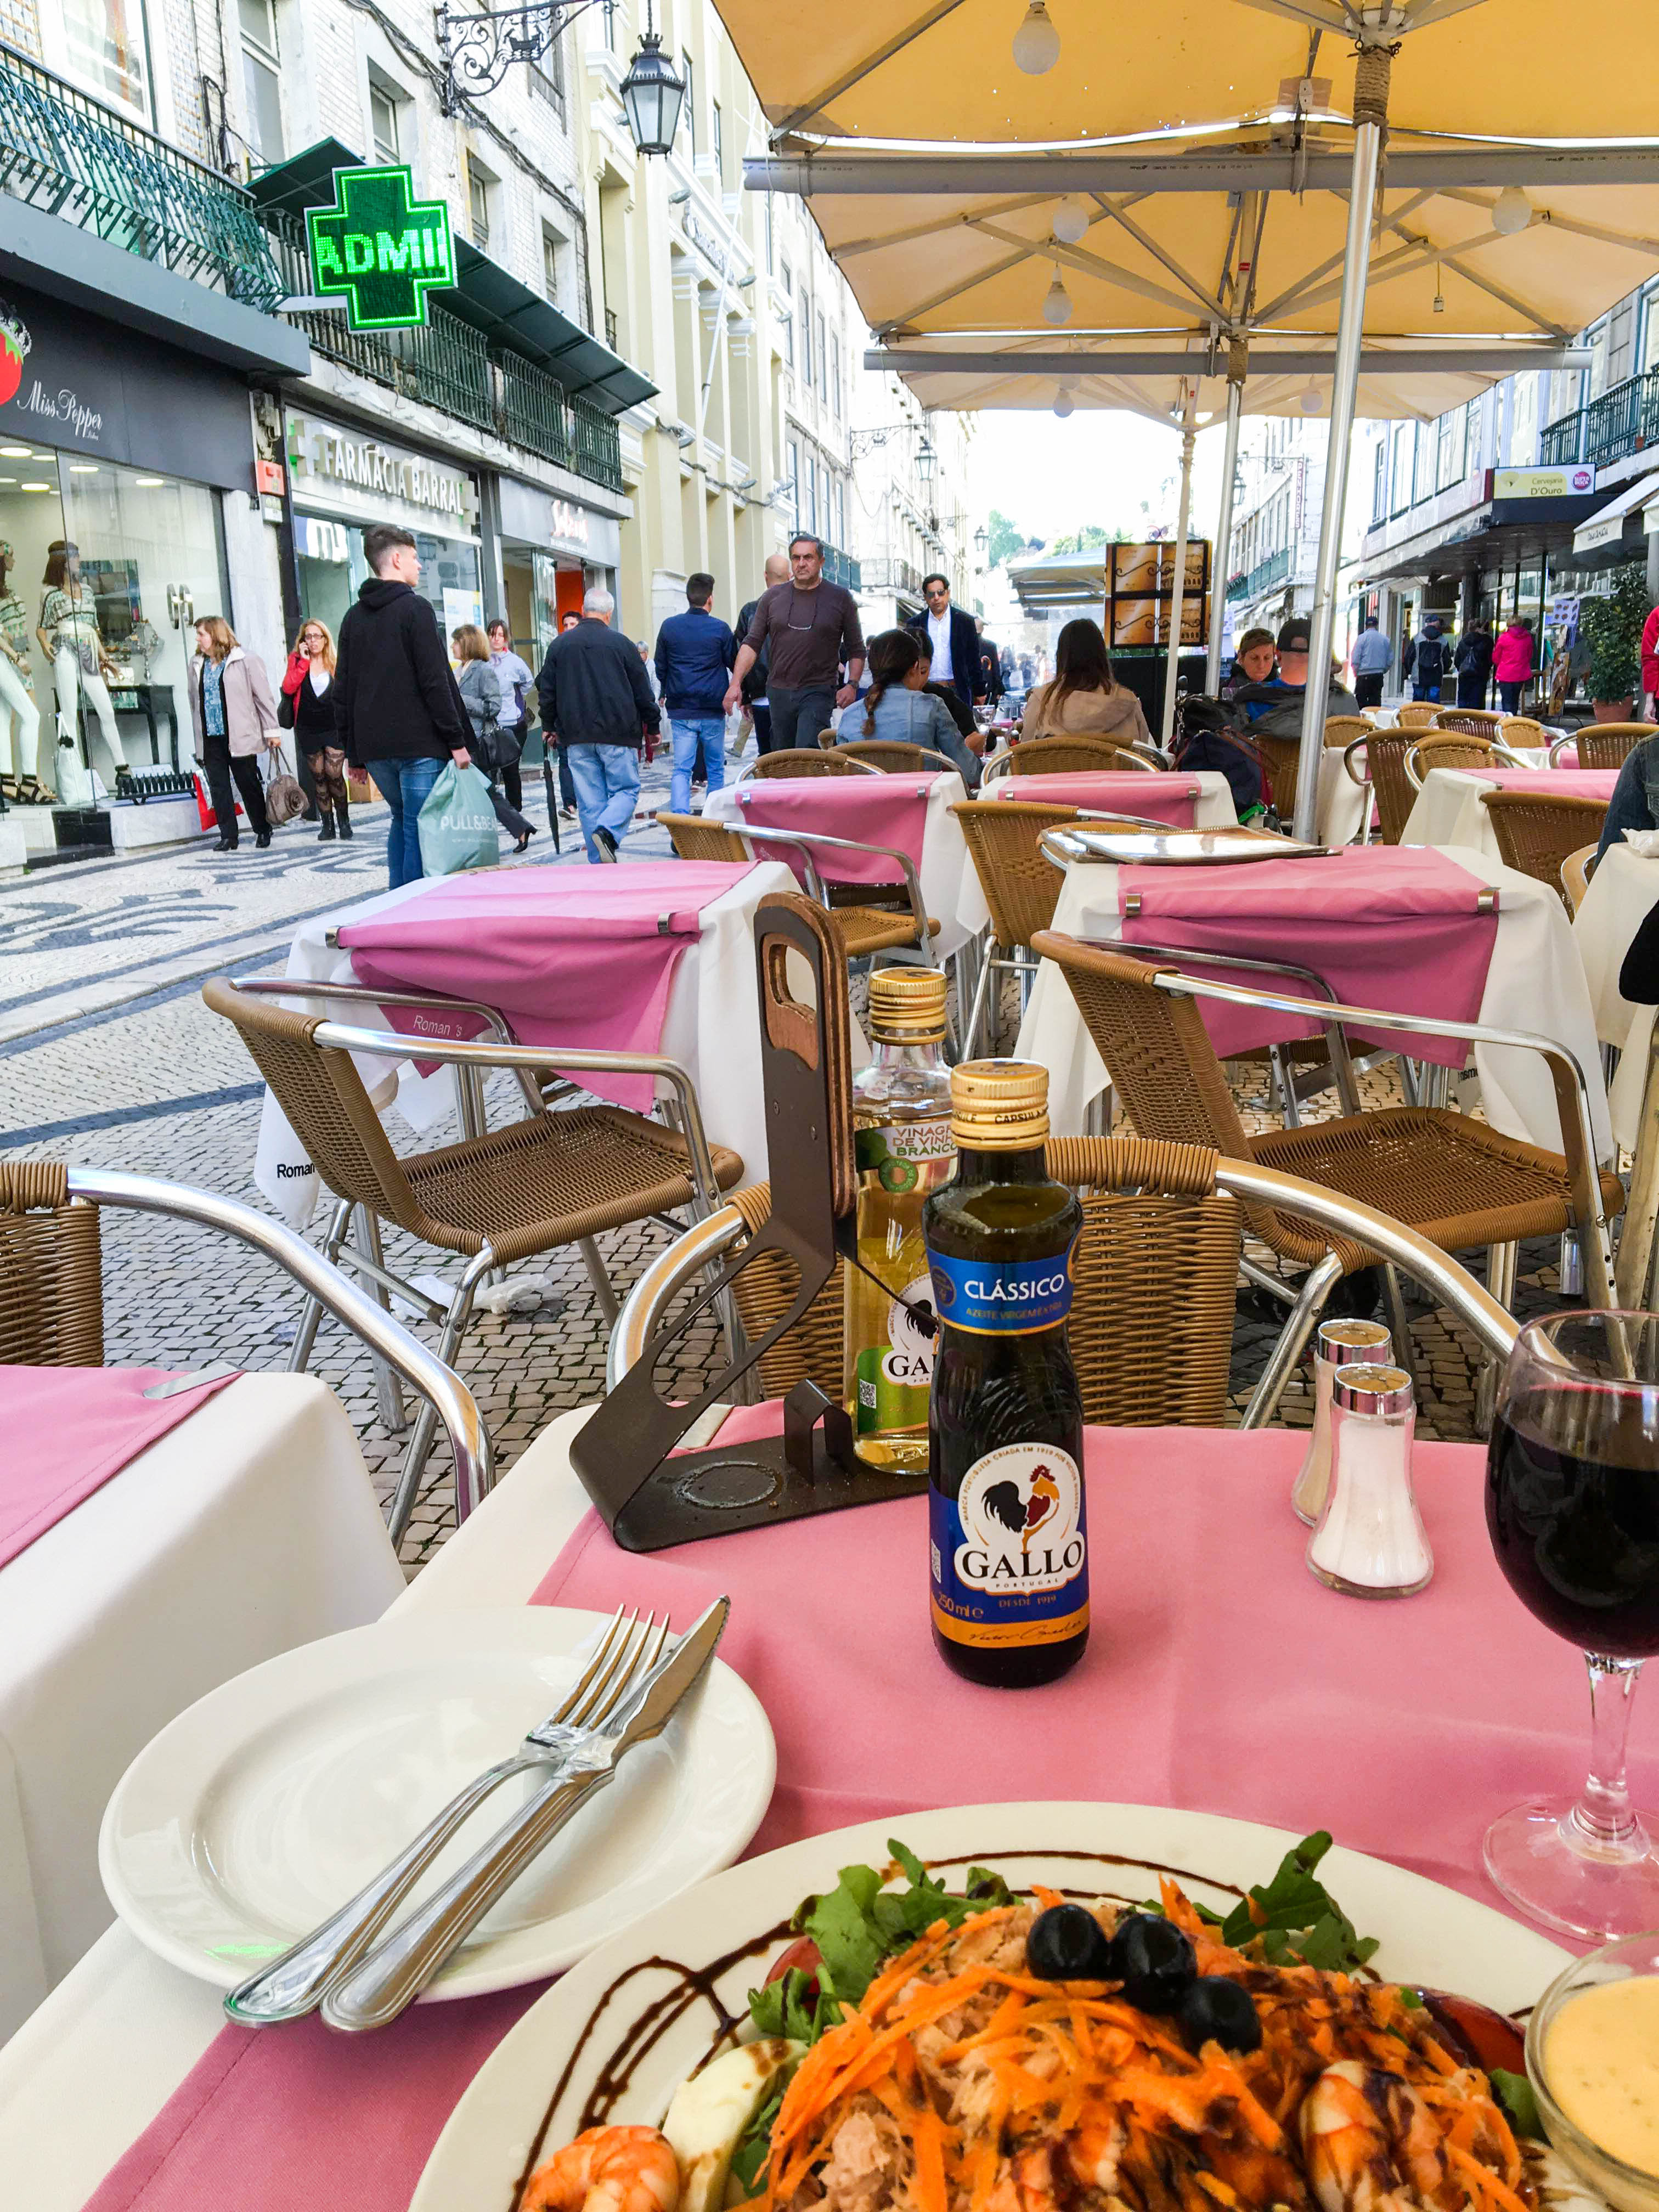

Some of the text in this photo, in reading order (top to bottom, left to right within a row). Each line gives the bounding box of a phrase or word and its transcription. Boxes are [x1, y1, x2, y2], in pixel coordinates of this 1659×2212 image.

[17, 380, 103, 438] Miss Pepper
[411, 466, 464, 515] BARRAL
[1531, 487, 1562, 495] D'Ouro
[413, 1014, 450, 1036] Roman
[893, 1137, 915, 1147] DE
[277, 1163, 315, 1178] Roman
[964, 1274, 1064, 1300] CLÁSSICO
[962, 1540, 1082, 1579] GALLO
[996, 1578, 1059, 1588] PORTUGAL
[998, 1598, 1031, 1608] DESDE
